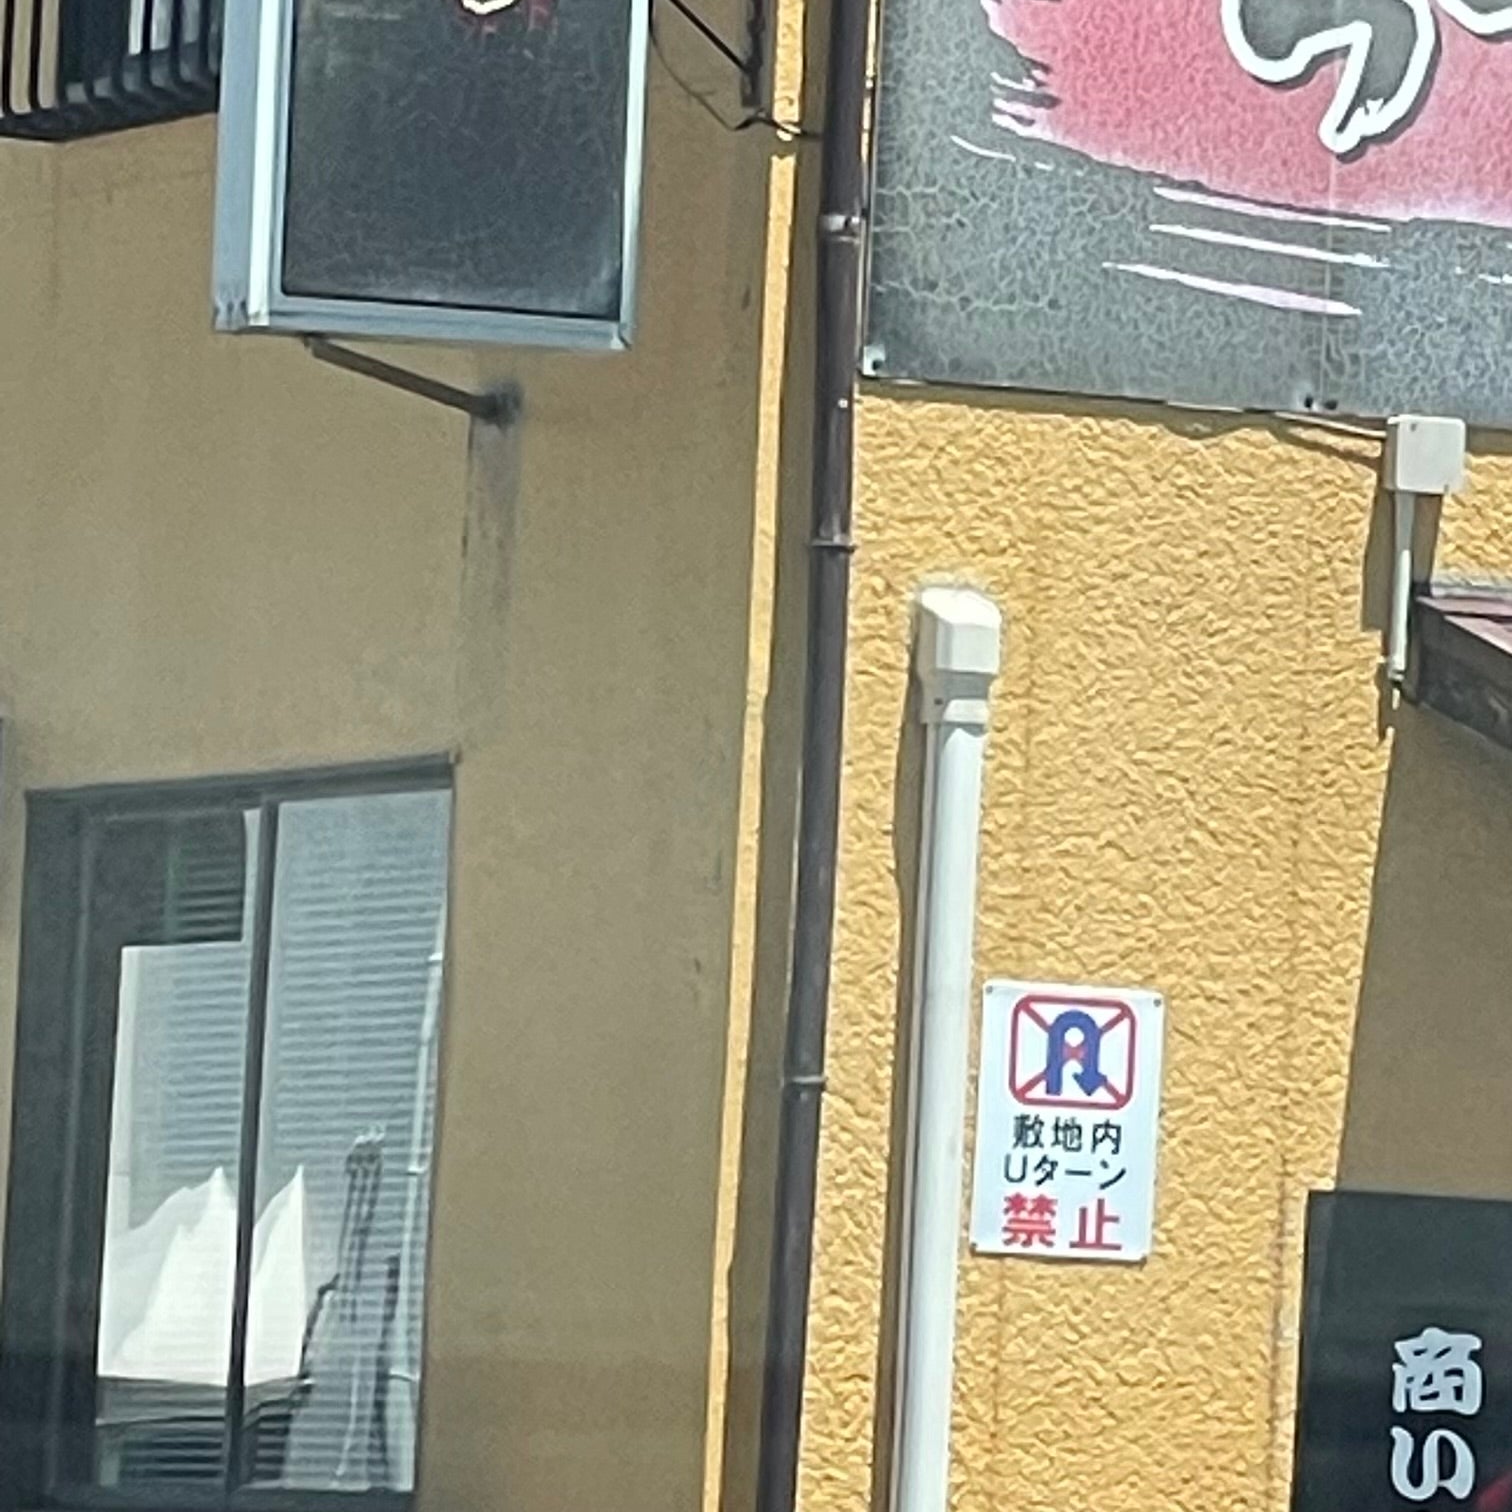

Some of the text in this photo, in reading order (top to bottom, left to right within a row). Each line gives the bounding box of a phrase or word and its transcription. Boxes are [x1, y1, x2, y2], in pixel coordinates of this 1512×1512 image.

[1013, 1114, 1122, 1155] 敷地内
[1004, 1154, 1127, 1191] Uターン
[1002, 1193, 1123, 1252] 禁止
[1390, 1326, 1483, 1502] 商い
